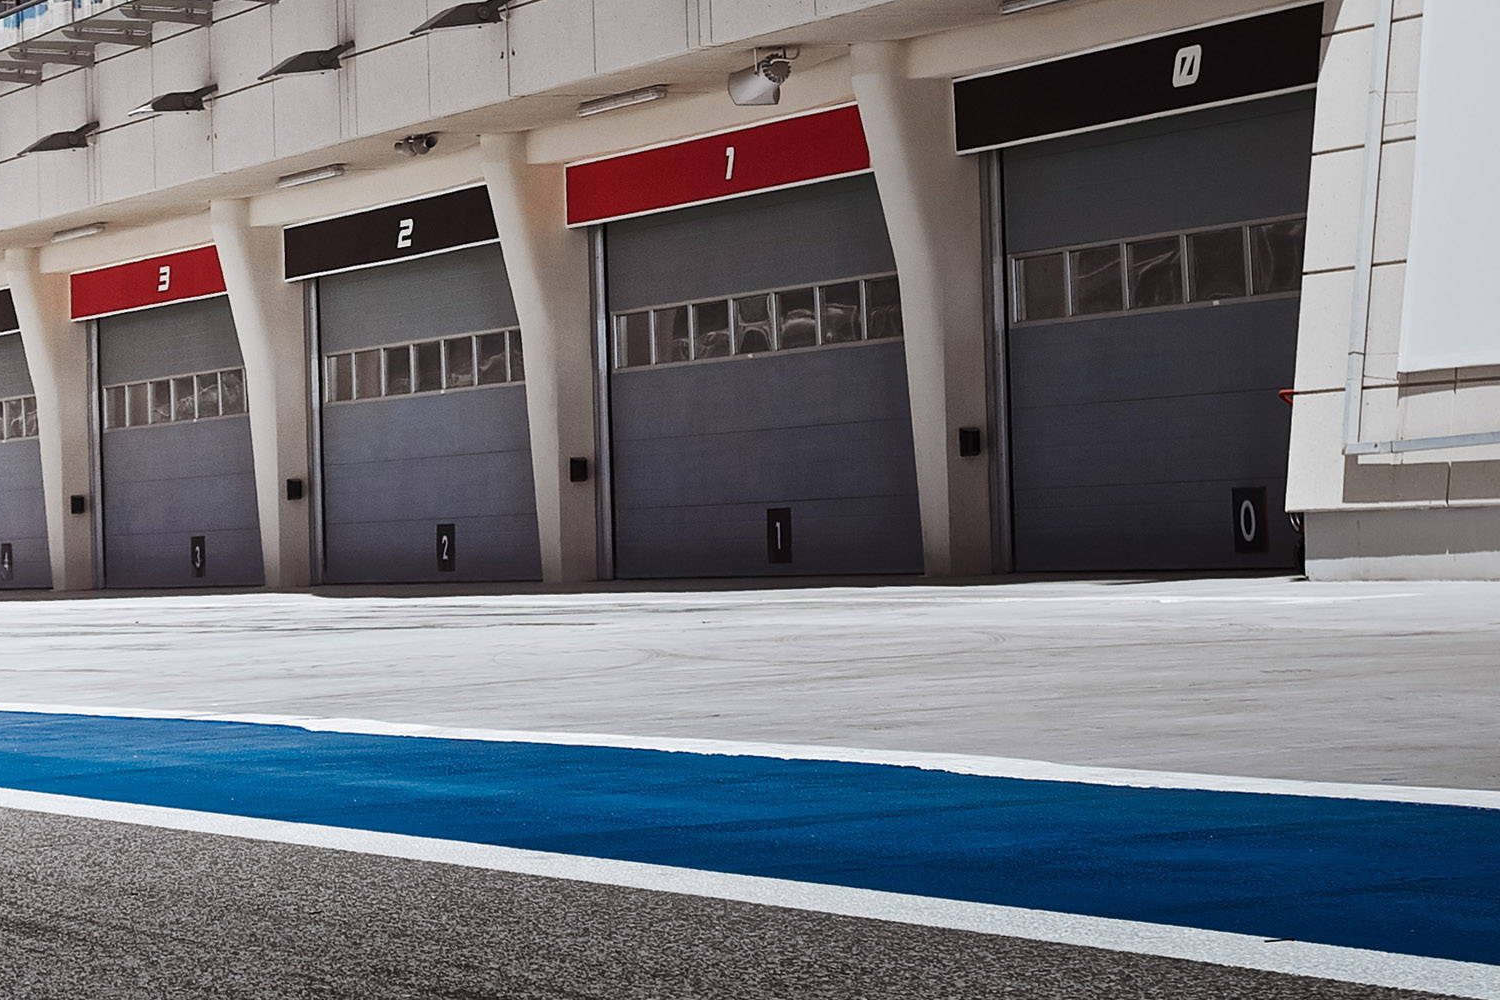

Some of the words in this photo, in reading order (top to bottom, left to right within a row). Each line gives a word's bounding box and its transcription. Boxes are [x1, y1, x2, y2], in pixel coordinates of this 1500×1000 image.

[1172, 44, 1202, 88] 0
[725, 146, 735, 180] 1
[397, 218, 414, 249] 2
[157, 265, 170, 292] 3
[775, 521, 781, 549] 1
[1240, 499, 1256, 542] 0
[194, 545, 201, 568] 3
[441, 535, 448, 560] 2
